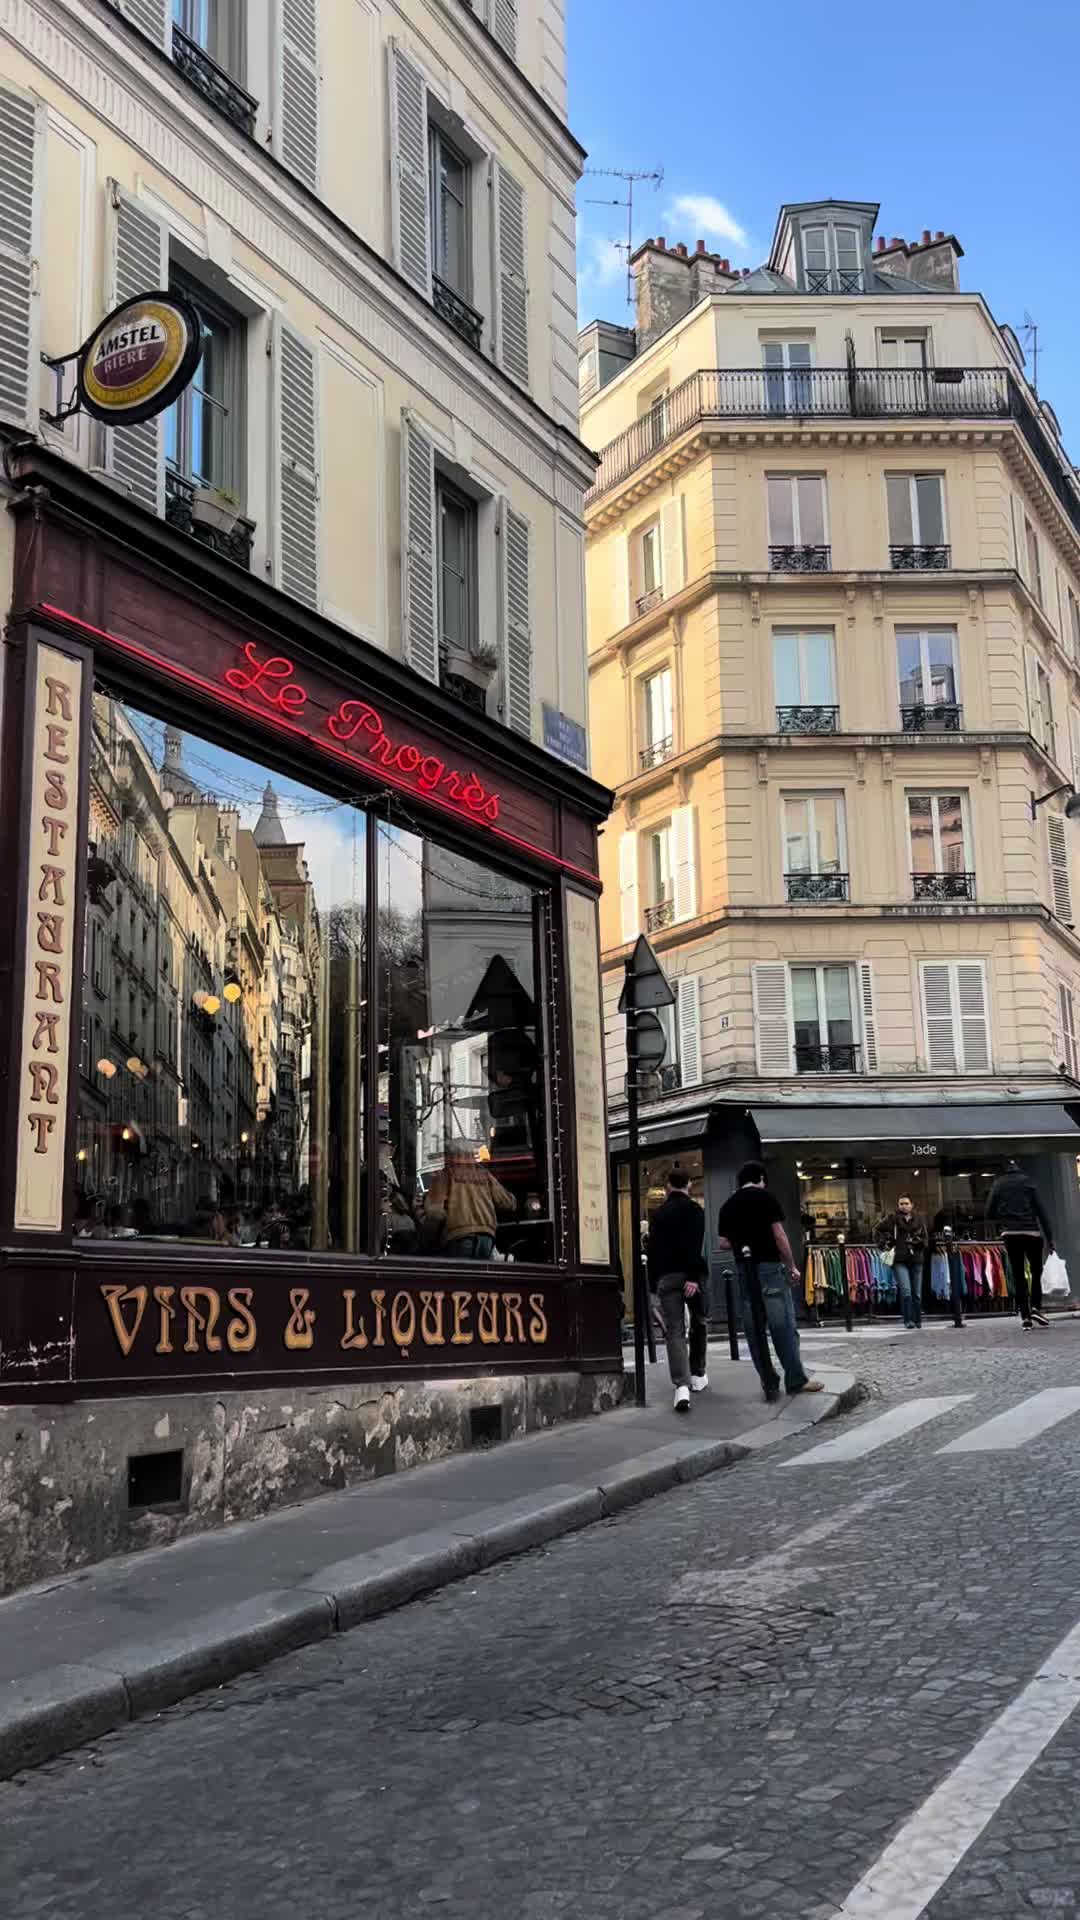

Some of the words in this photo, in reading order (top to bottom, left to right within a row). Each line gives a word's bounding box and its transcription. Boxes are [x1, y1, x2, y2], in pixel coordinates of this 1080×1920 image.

[96, 325, 160, 361] AMSTEL
[225, 641, 307, 715] Le
[328, 700, 499, 819] Progrès
[28, 676, 73, 1154] RESTAURANT
[911, 1143, 937, 1155] Jade
[100, 1284, 257, 1356] VINS
[284, 1287, 316, 1350] &
[340, 1289, 548, 1360] LIQUEURS
